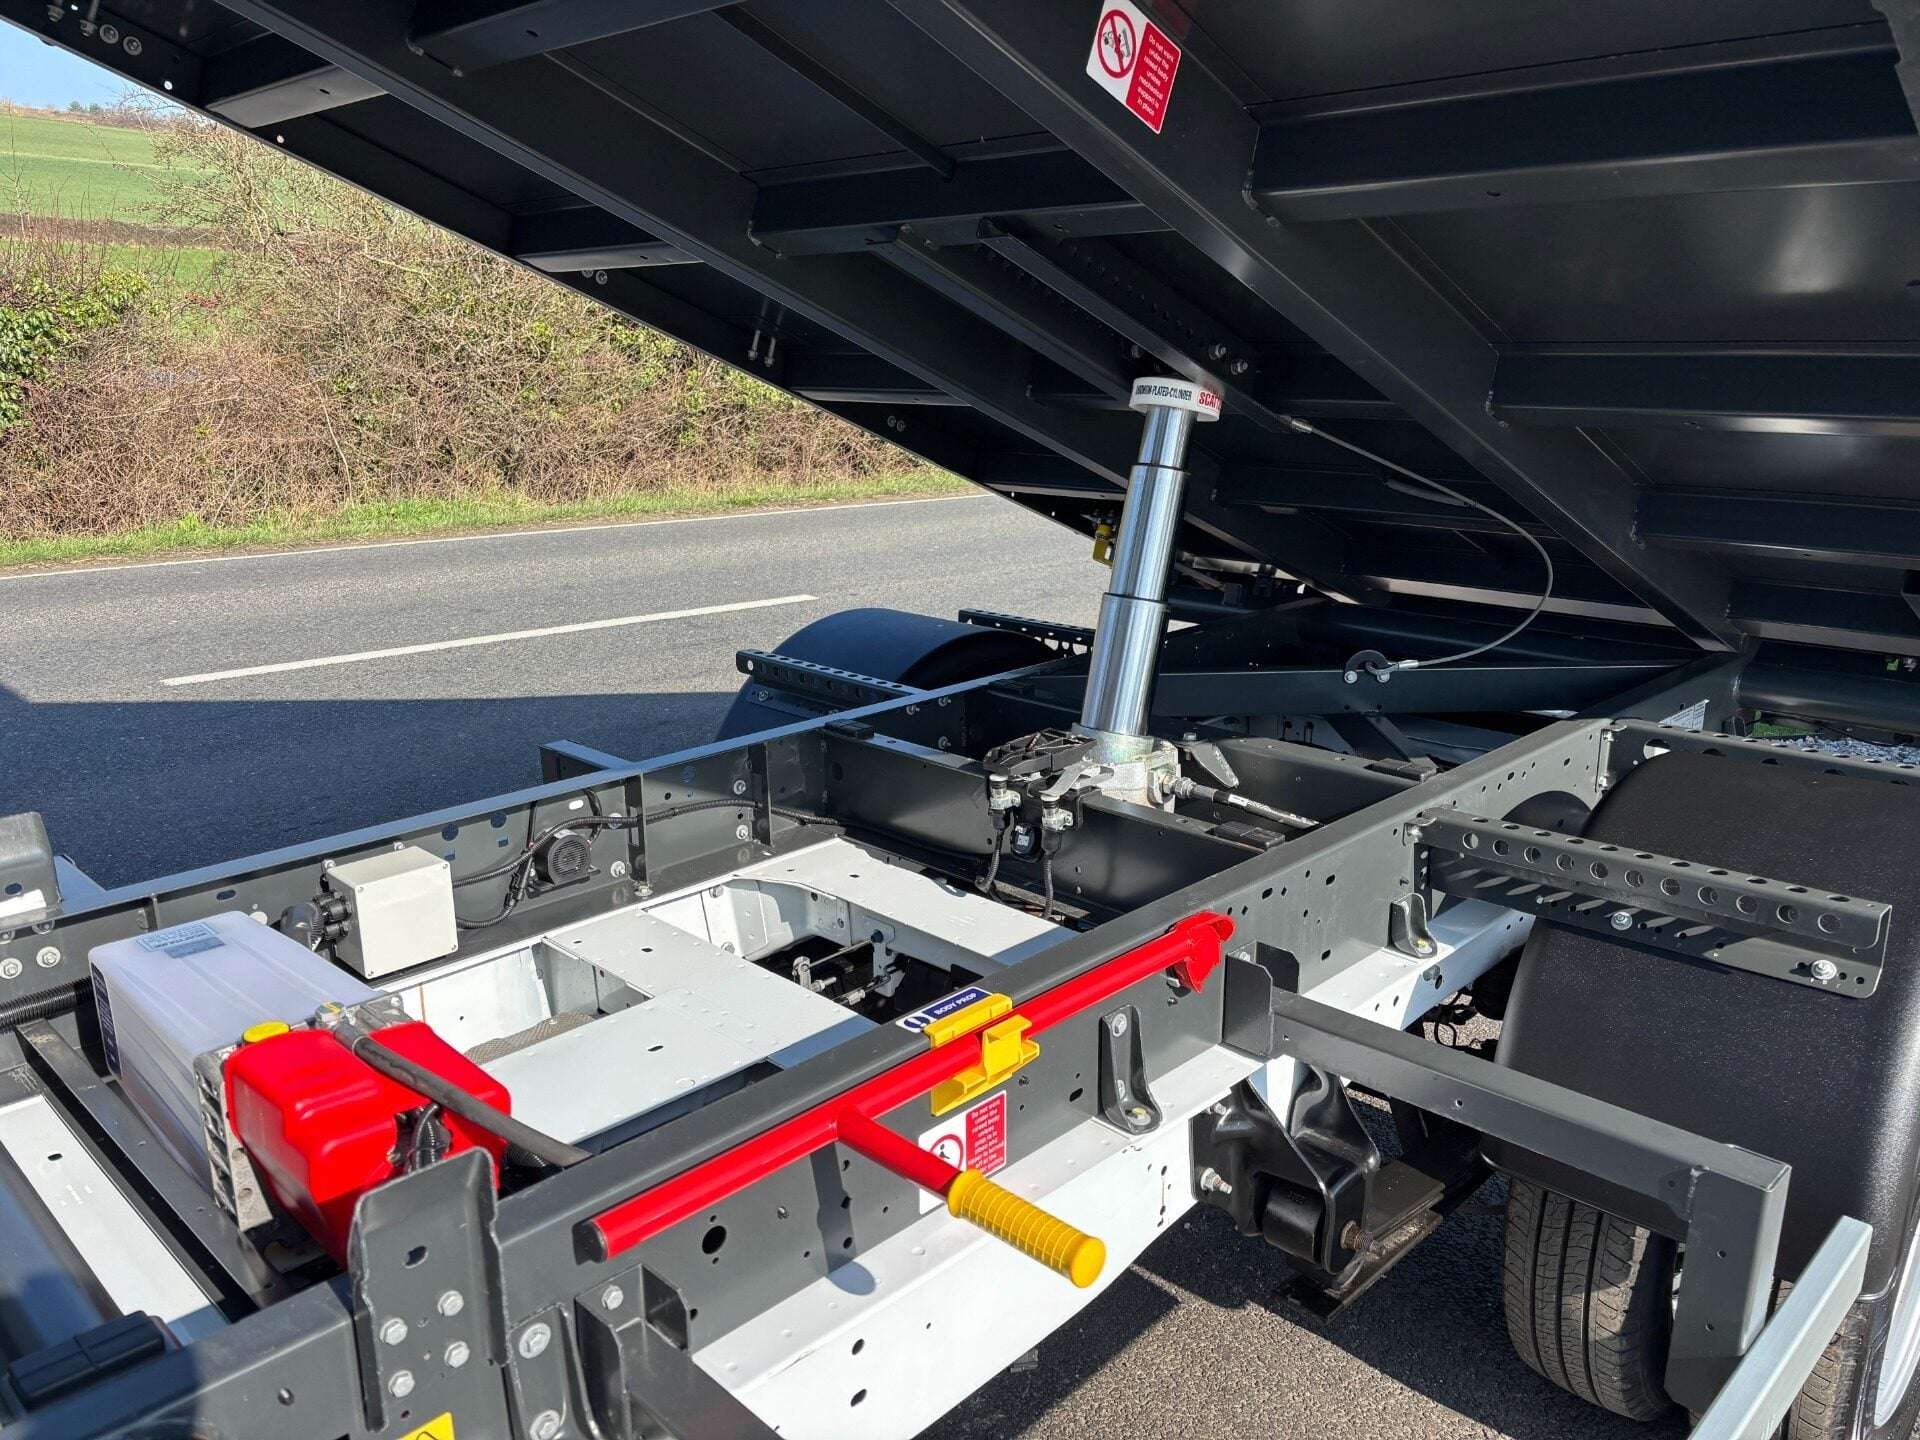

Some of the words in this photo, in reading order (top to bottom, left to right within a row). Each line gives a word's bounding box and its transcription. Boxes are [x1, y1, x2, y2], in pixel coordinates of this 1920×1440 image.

[1148, 47, 1161, 62] under
[1161, 58, 1169, 70] the
[1149, 34, 1155, 45] Do
[1155, 42, 1163, 54] not
[1163, 49, 1174, 63] work
[1143, 55, 1158, 72] raised
[1157, 66, 1168, 82] body
[1146, 70, 1161, 86] unless
[1137, 86, 1155, 104] support
[1142, 102, 1154, 116] place
[933, 1002, 956, 1015] BODY
[955, 992, 977, 1005] PROP
[979, 1105, 988, 1115] not
[988, 1099, 1000, 1109] work
